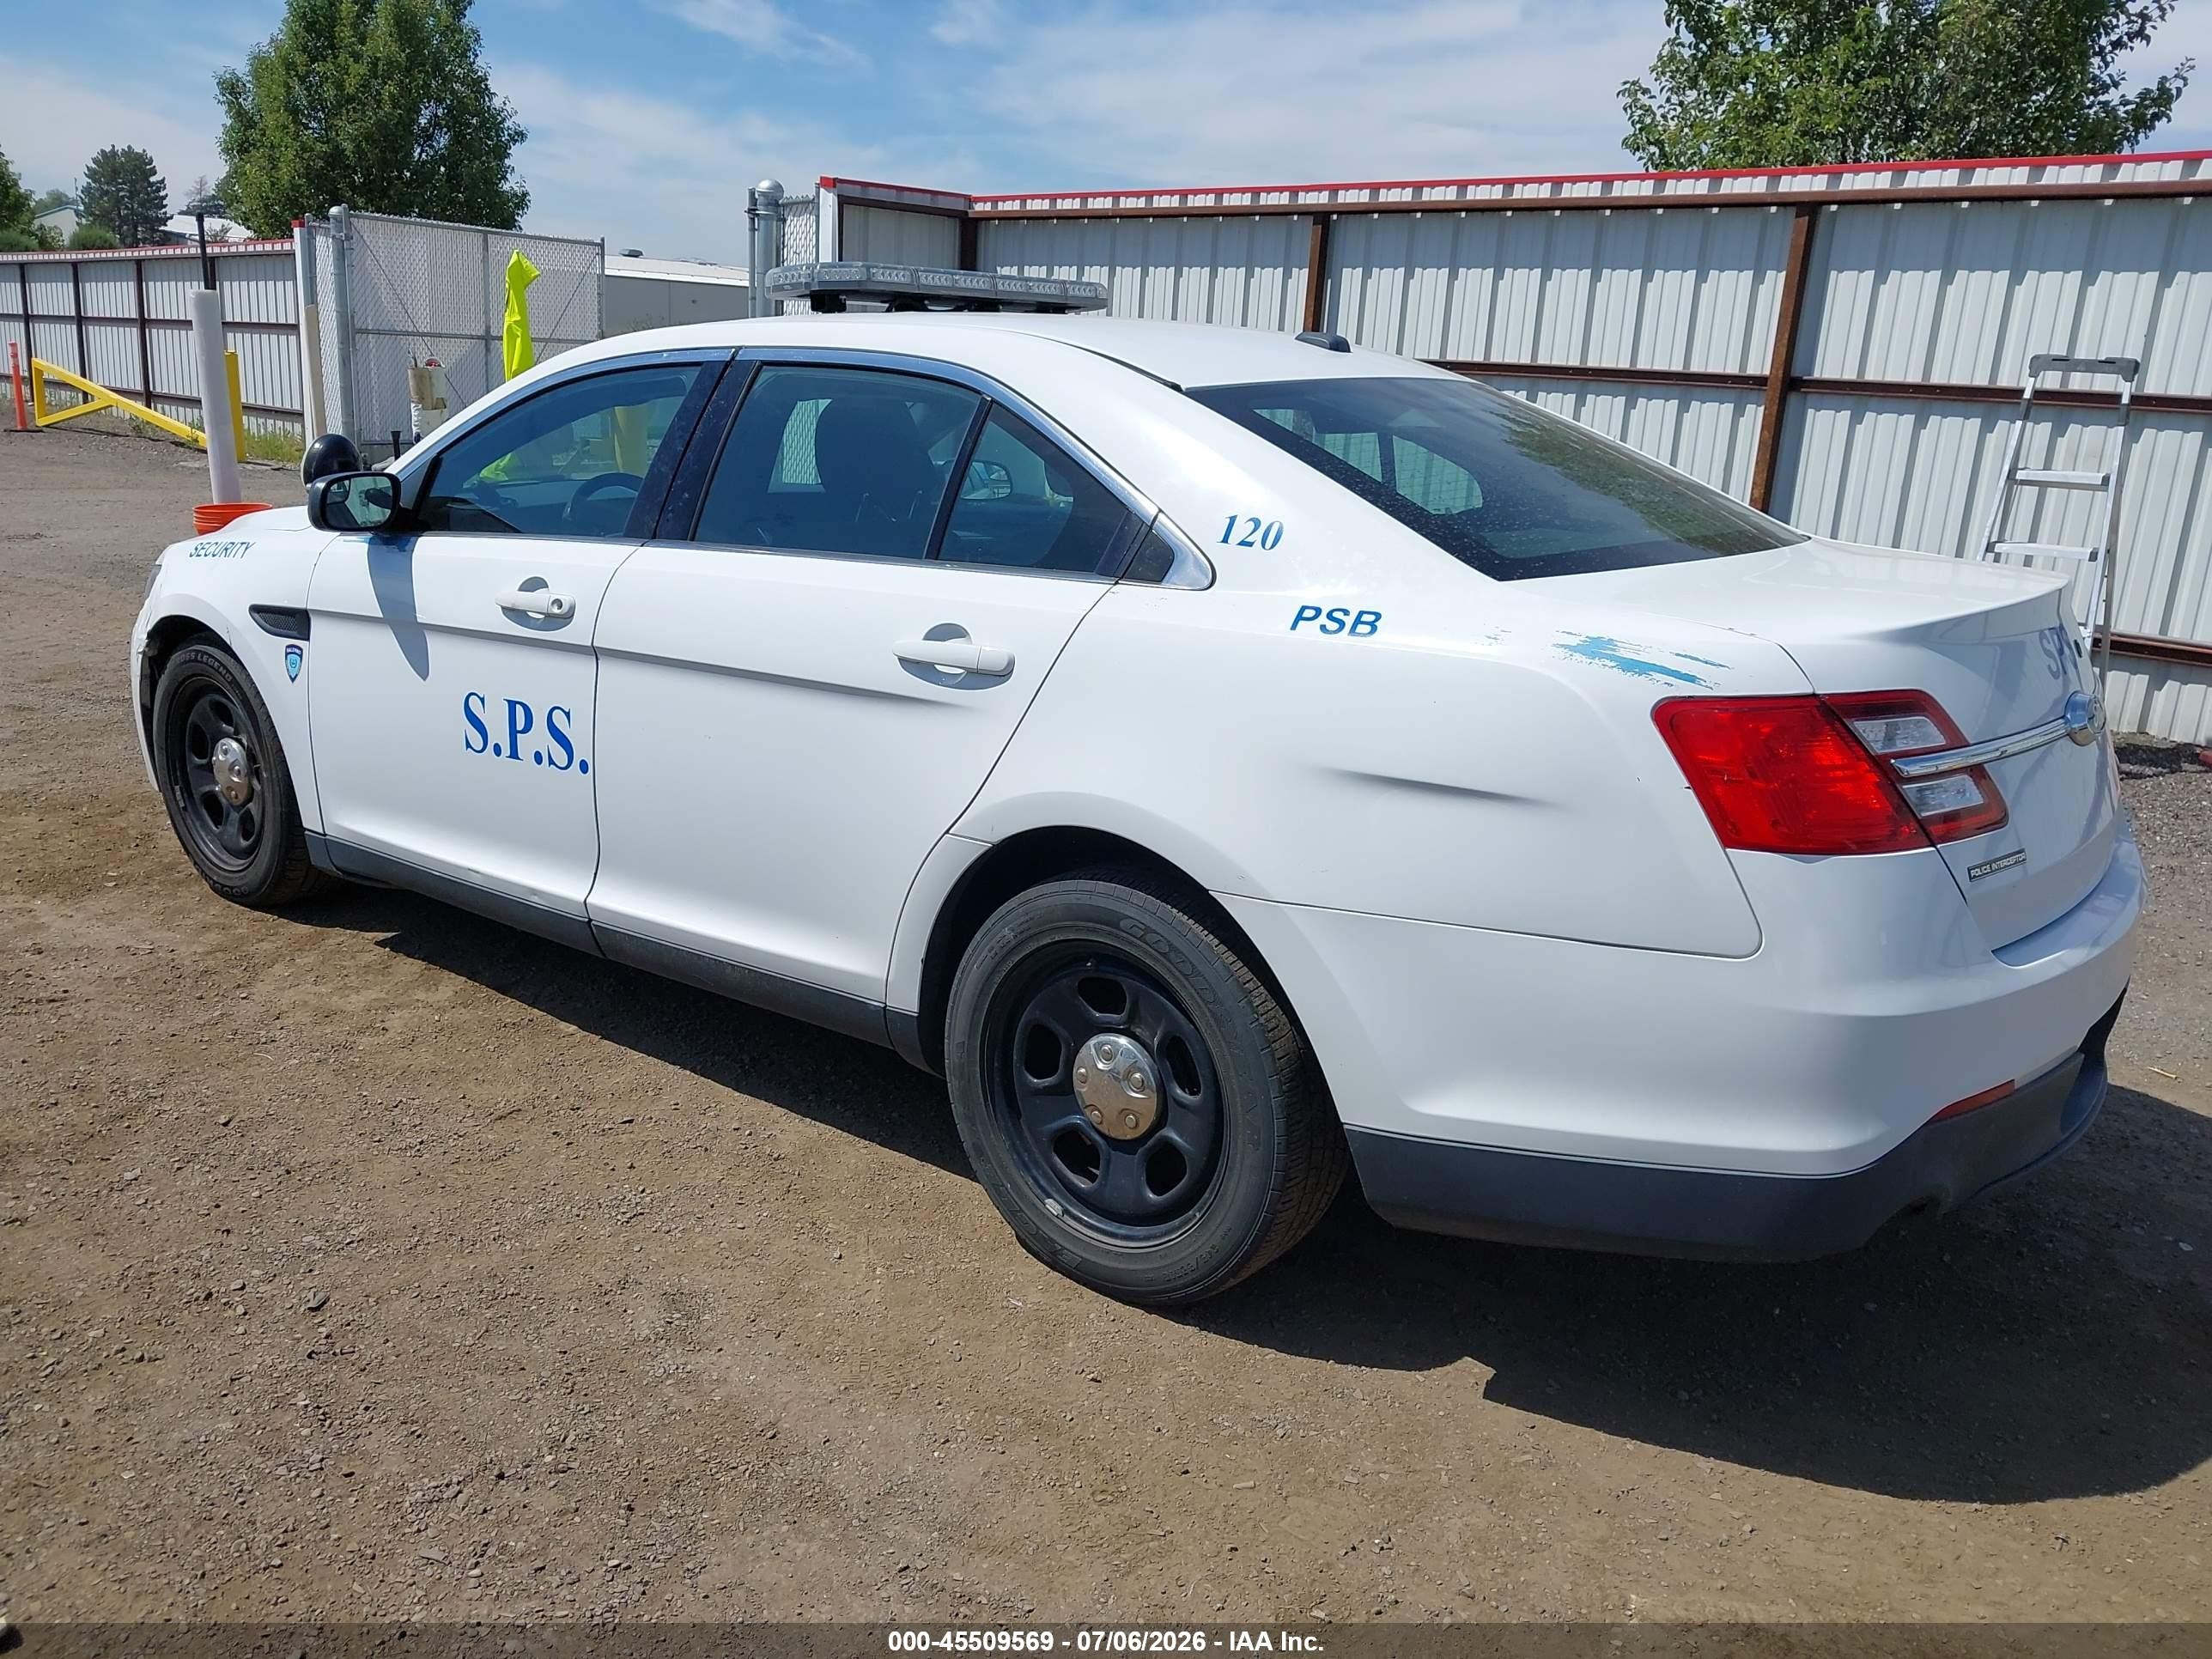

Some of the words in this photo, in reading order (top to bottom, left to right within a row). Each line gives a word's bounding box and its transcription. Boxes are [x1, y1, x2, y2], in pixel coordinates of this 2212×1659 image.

[1217, 515, 1284, 550] 120
[189, 541, 256, 558] SECURITY
[1290, 605, 1382, 637] PSB
[464, 692, 589, 775] S.P.S.
[1970, 865, 1991, 878] POLICE
[1991, 853, 2026, 870] INTERCEPTOR
